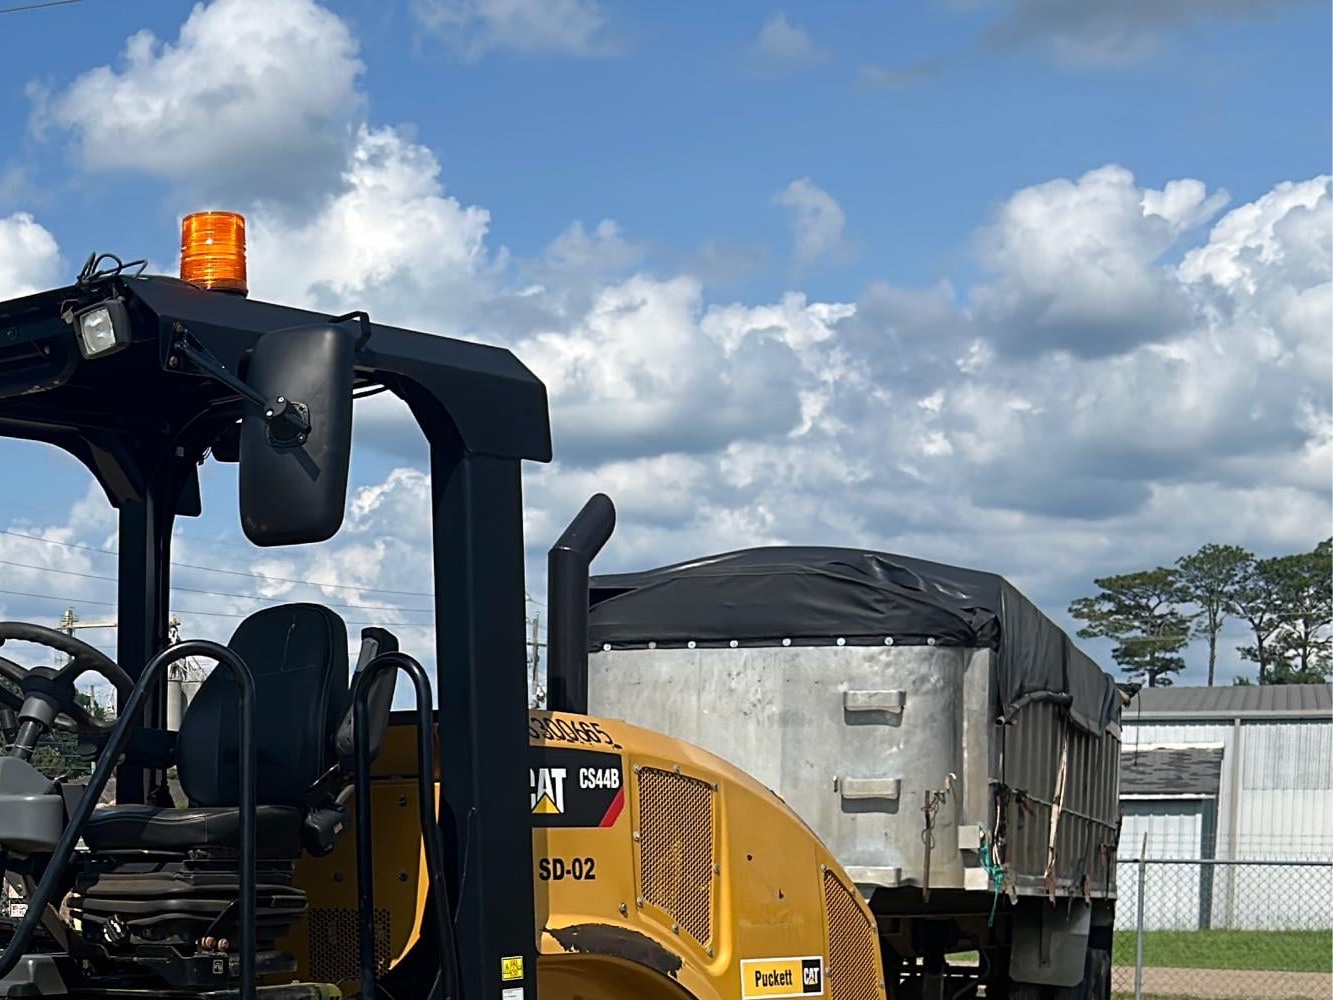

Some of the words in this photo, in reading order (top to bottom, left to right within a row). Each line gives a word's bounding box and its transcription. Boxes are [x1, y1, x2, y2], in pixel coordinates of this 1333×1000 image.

[579, 767, 620, 789] CS44B
[538, 857, 596, 881] SD-02
[754, 969, 793, 987] Puckett
[803, 967, 820, 985] CAT
